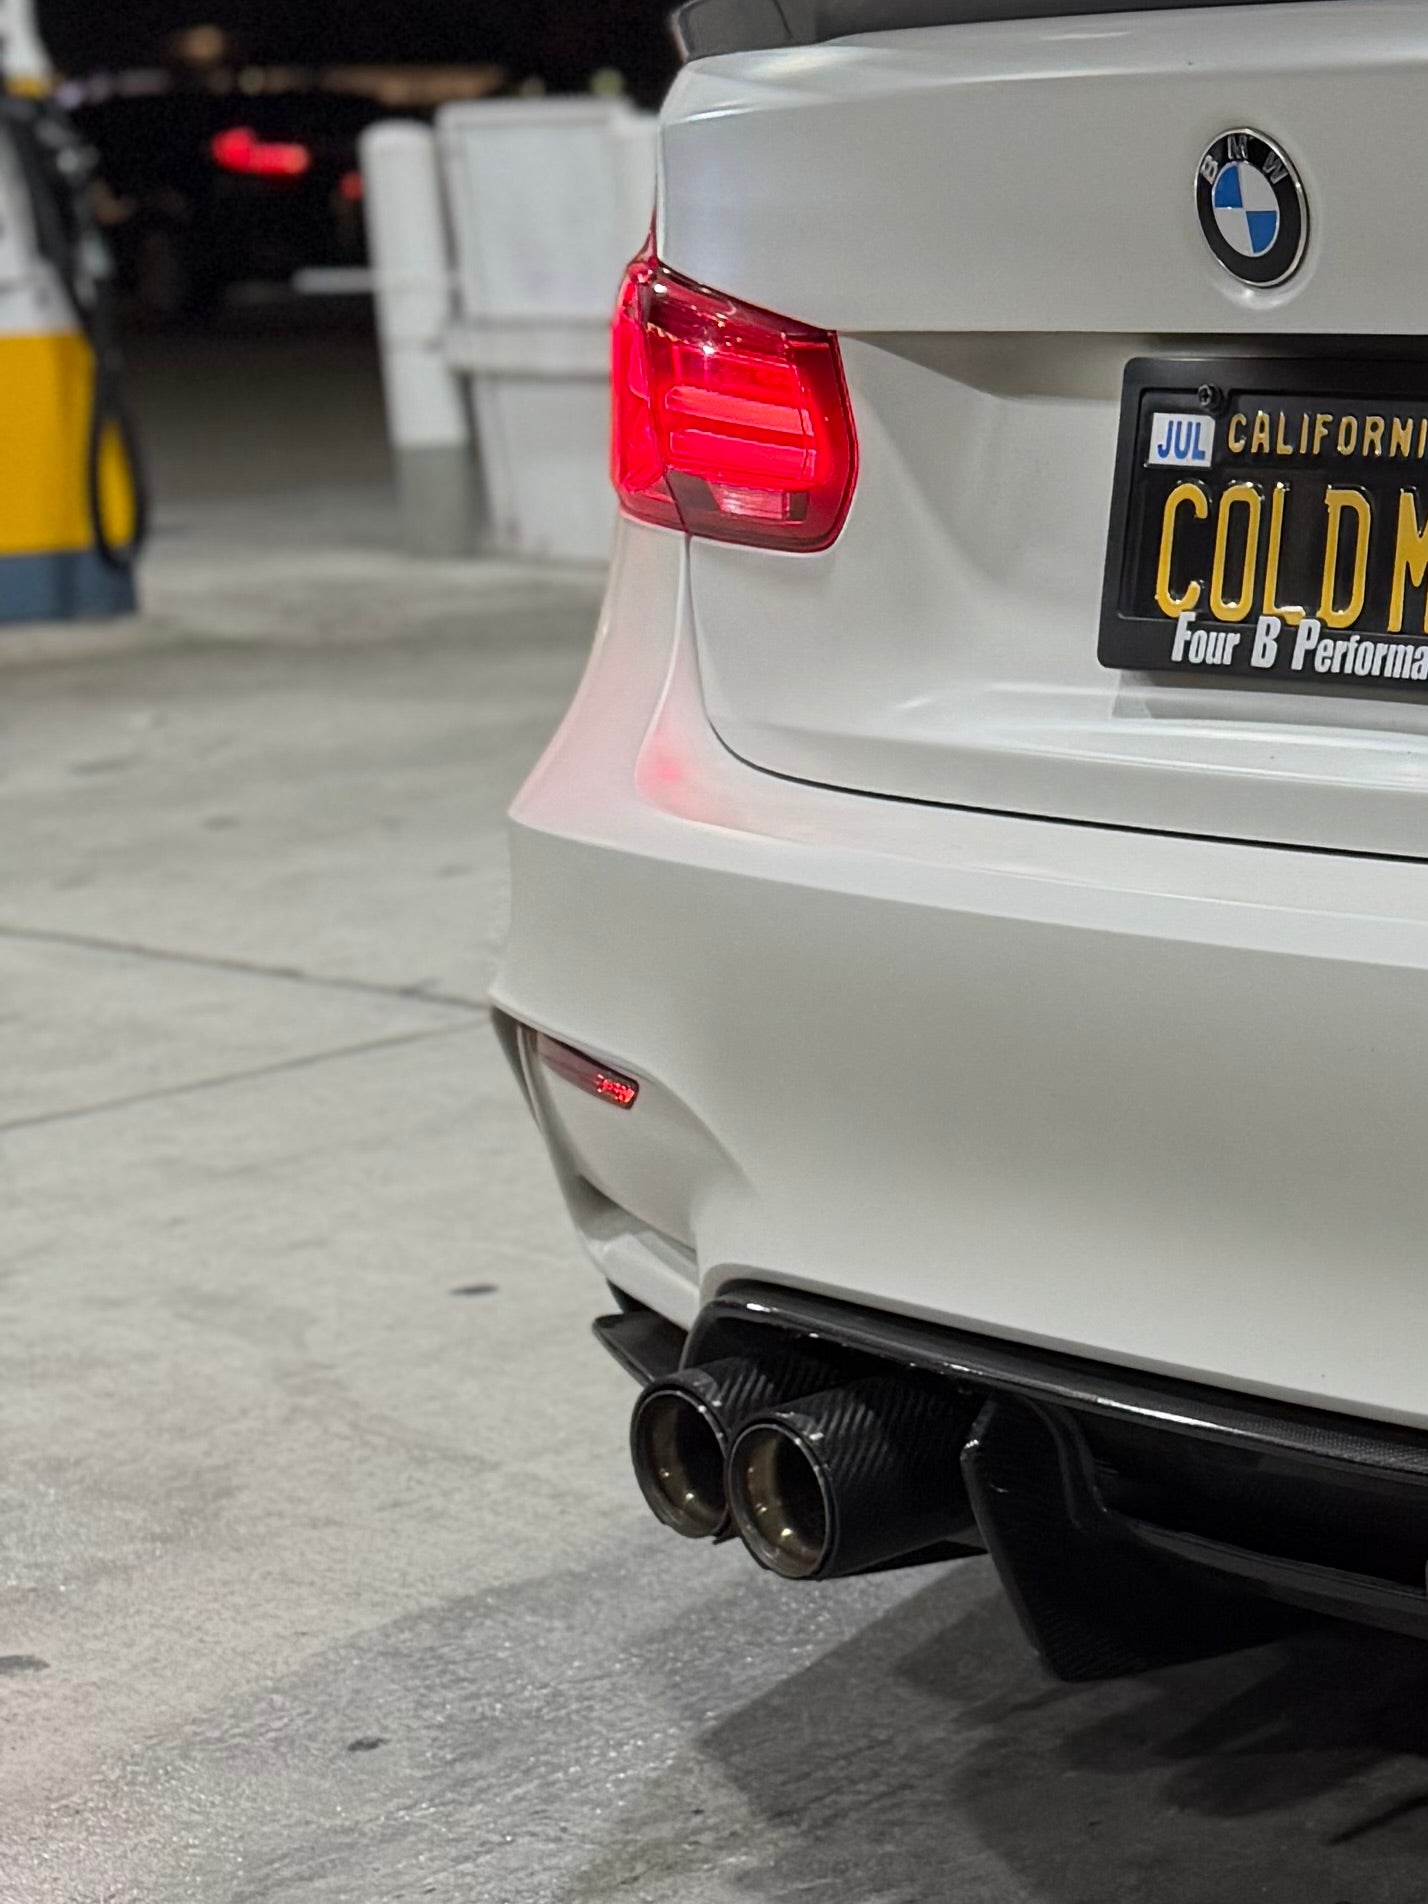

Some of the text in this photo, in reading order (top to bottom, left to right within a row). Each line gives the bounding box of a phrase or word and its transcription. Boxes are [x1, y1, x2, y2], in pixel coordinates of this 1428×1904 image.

[1200, 134, 1289, 185] BMW
[1157, 419, 1206, 462] JUL
[1171, 611, 1242, 666] Four
[1250, 614, 1282, 669] B
